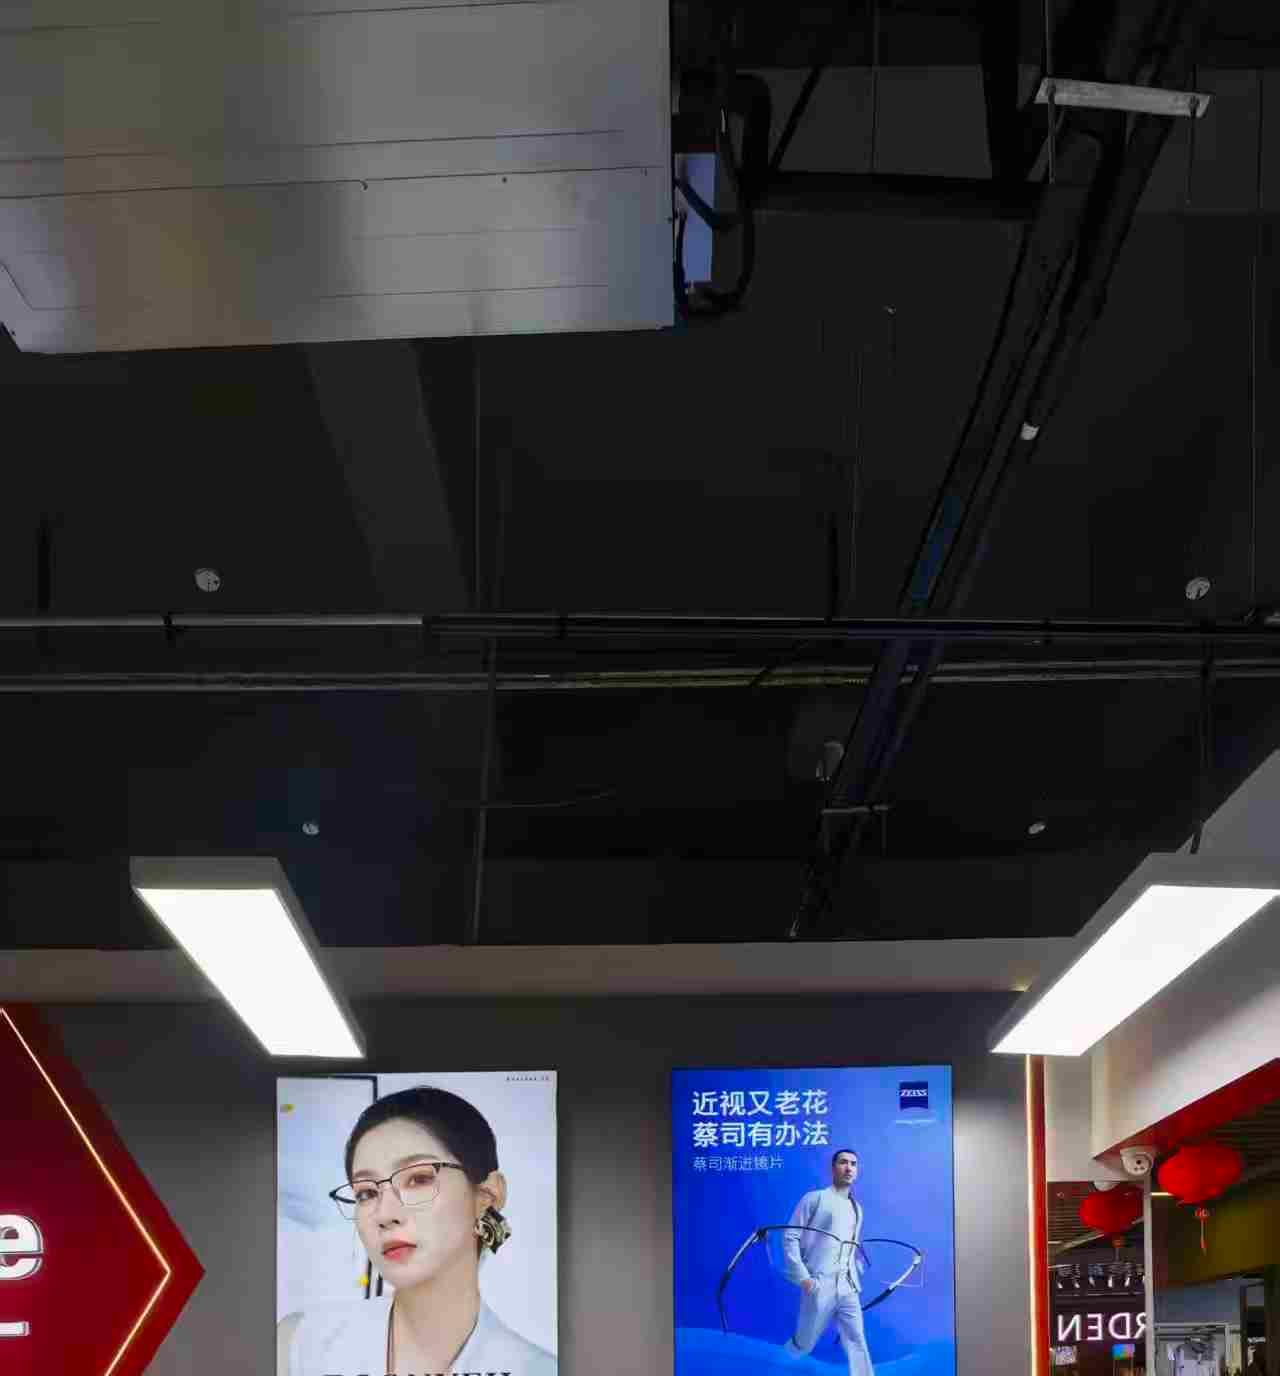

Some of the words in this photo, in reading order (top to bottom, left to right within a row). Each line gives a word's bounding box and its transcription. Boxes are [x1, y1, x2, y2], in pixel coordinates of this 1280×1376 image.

[693, 1089, 828, 1116] 近视又老花
[693, 1121, 829, 1147] 蔡司有办法
[693, 1154, 784, 1171] 蔡司渐进镜片
